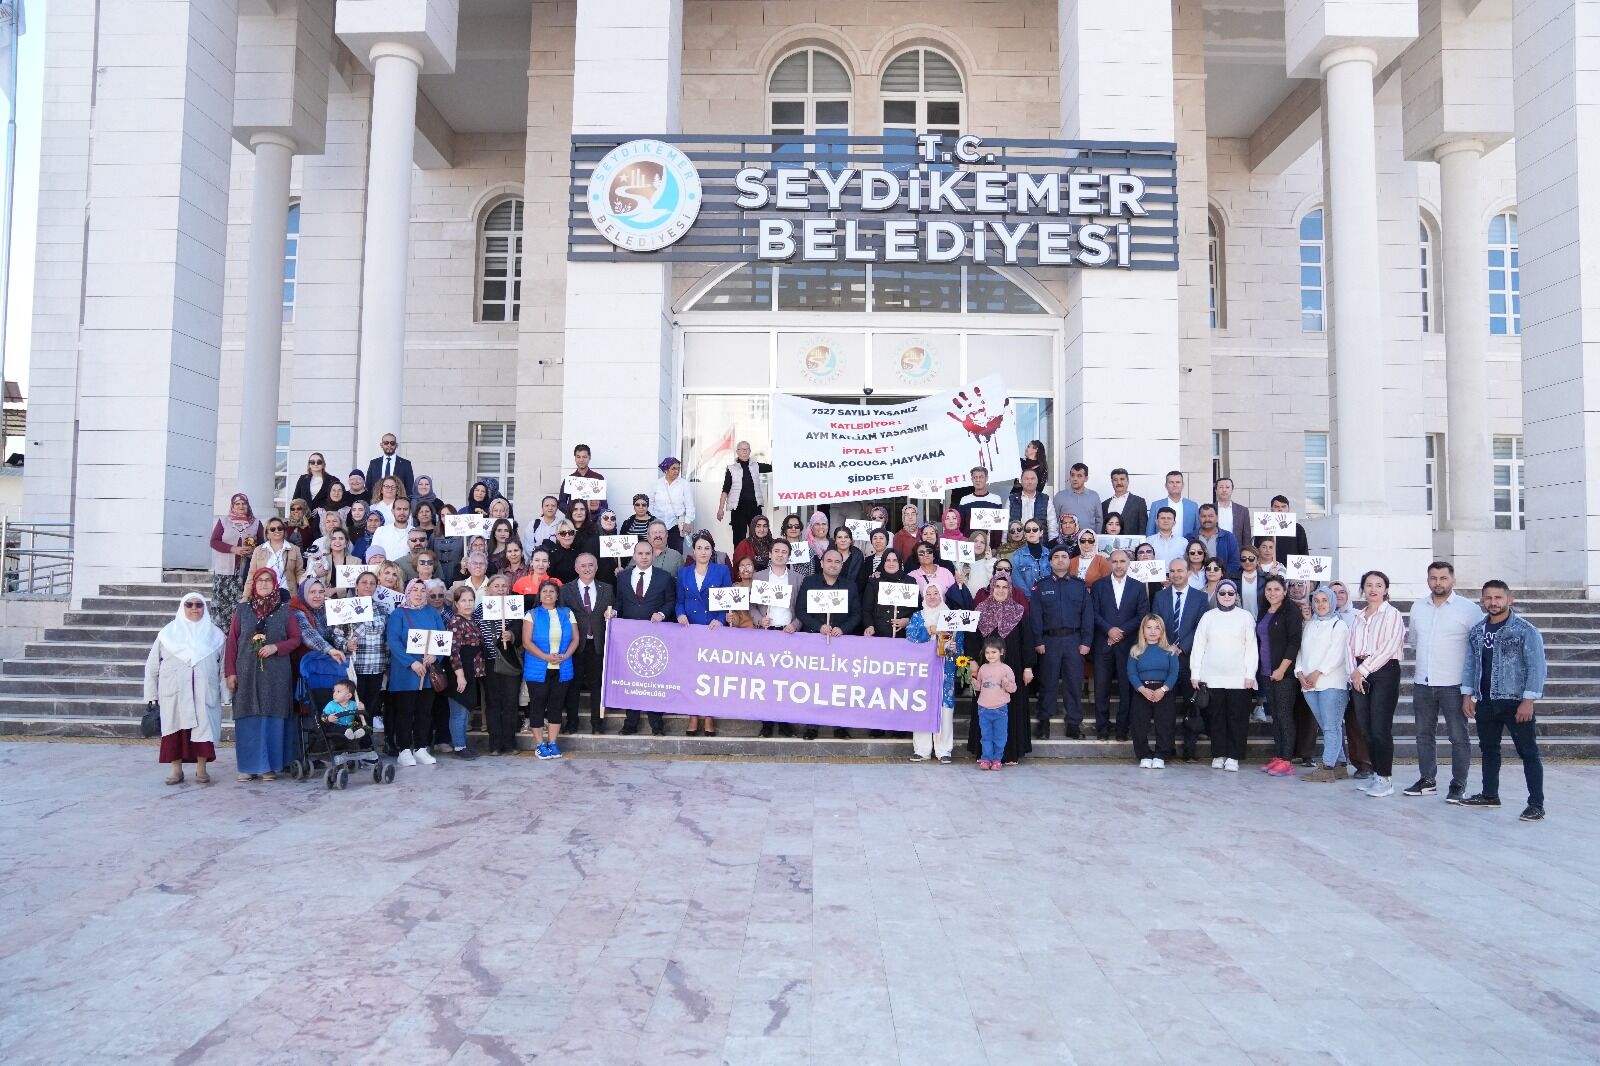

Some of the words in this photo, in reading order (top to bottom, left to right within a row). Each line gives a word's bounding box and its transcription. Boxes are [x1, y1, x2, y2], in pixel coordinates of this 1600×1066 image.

[918, 133, 995, 162] T.C.
[734, 167, 1149, 216] SEYDİKEMER
[758, 218, 1131, 267] BELEDİYESİ
[873, 405, 918, 416] YASANIZ
[806, 432, 829, 440] AYM
[880, 423, 929, 438] YASASINI
[830, 420, 896, 430] KATLEDİYOR
[842, 446, 873, 455] İPTAL
[875, 446, 889, 454] ET
[793, 460, 836, 469] KADINA
[847, 473, 894, 483] ŞİDDETE
[778, 491, 817, 500] YATARI
[819, 489, 850, 499] OLAN
[852, 486, 886, 497] HAPİS
[888, 484, 910, 493] CEZ
[697, 647, 766, 667] KADINA
[769, 650, 849, 673] YÖNELİK
[851, 656, 929, 678] ŞİDDETE
[695, 674, 766, 701] SIFIR
[772, 679, 928, 712] TOLERANS
